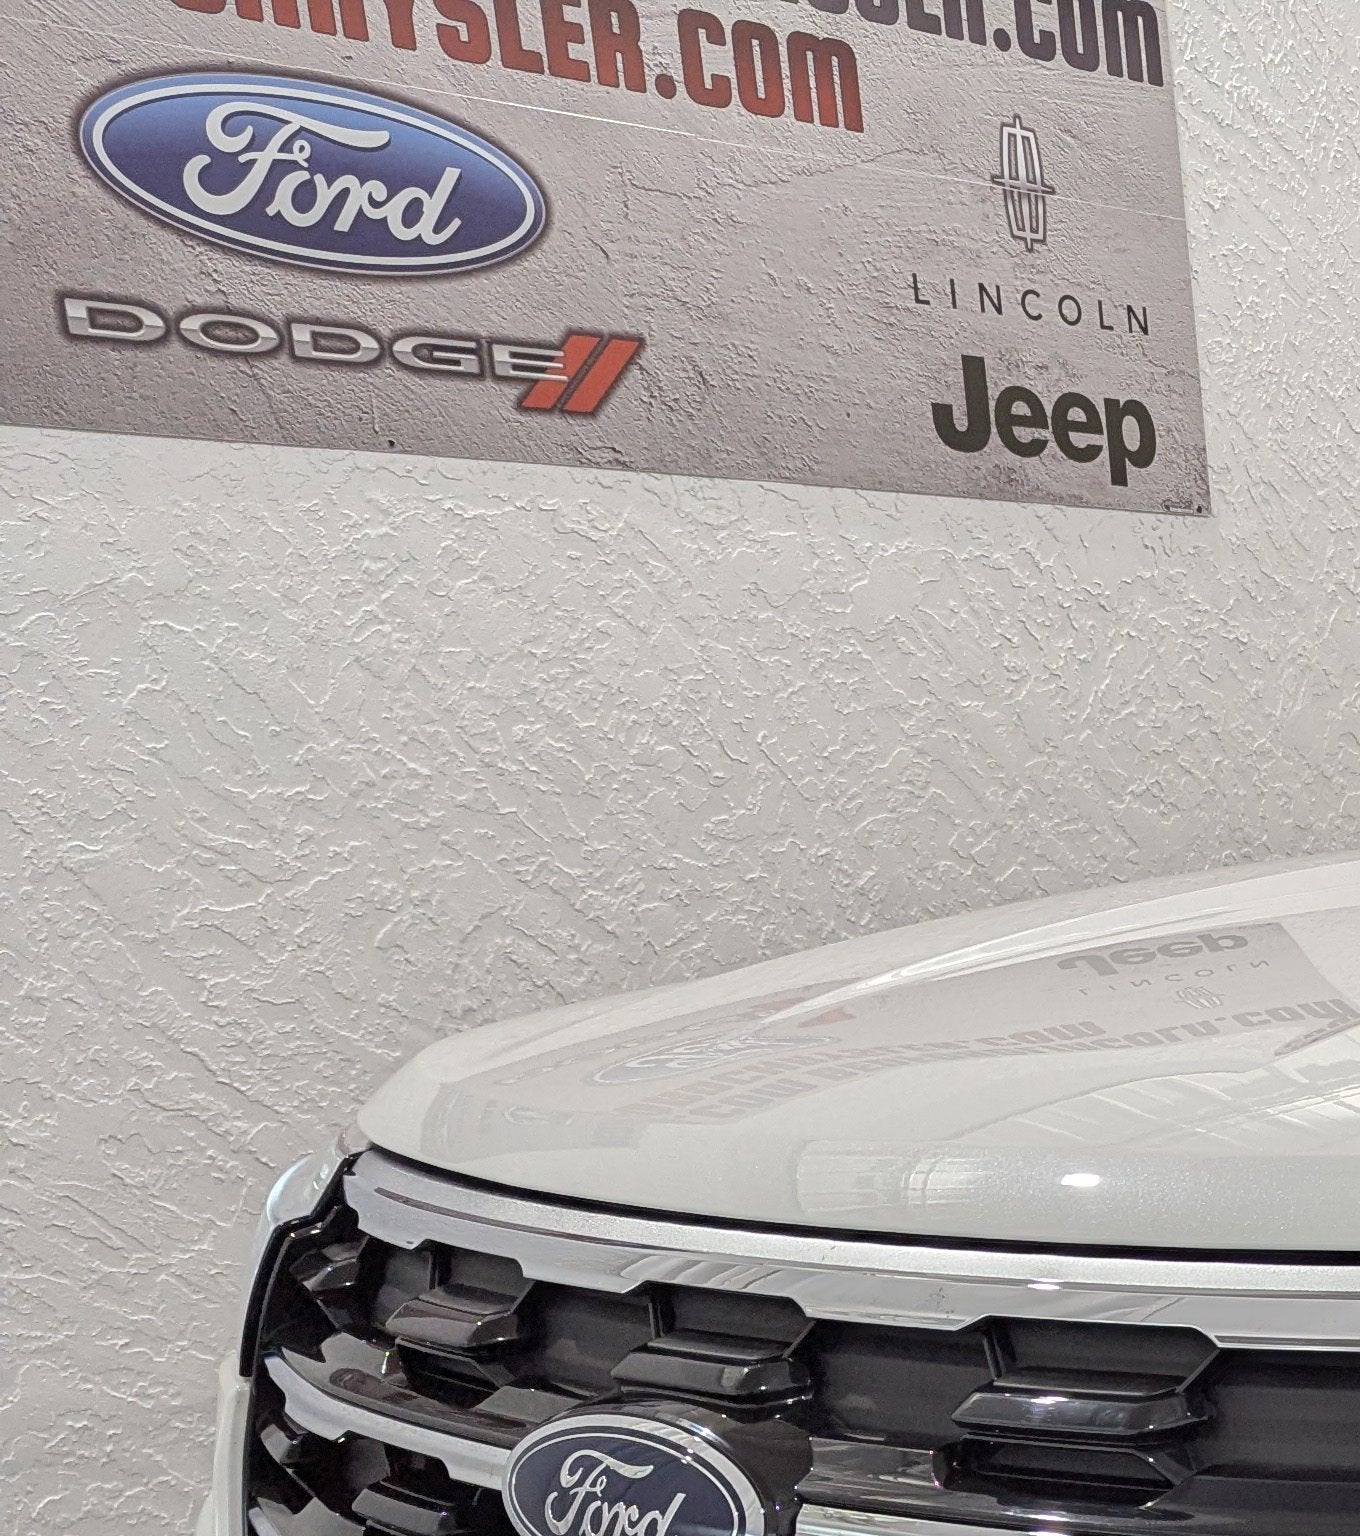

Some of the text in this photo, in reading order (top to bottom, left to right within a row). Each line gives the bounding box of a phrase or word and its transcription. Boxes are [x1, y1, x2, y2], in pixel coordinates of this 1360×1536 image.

[172, 0, 864, 132] YSLER.COM
[184, 100, 463, 249] Ford
[63, 296, 570, 382] DODGE
[911, 272, 1150, 336] LINCOLN
[930, 353, 1157, 487] Jeep
